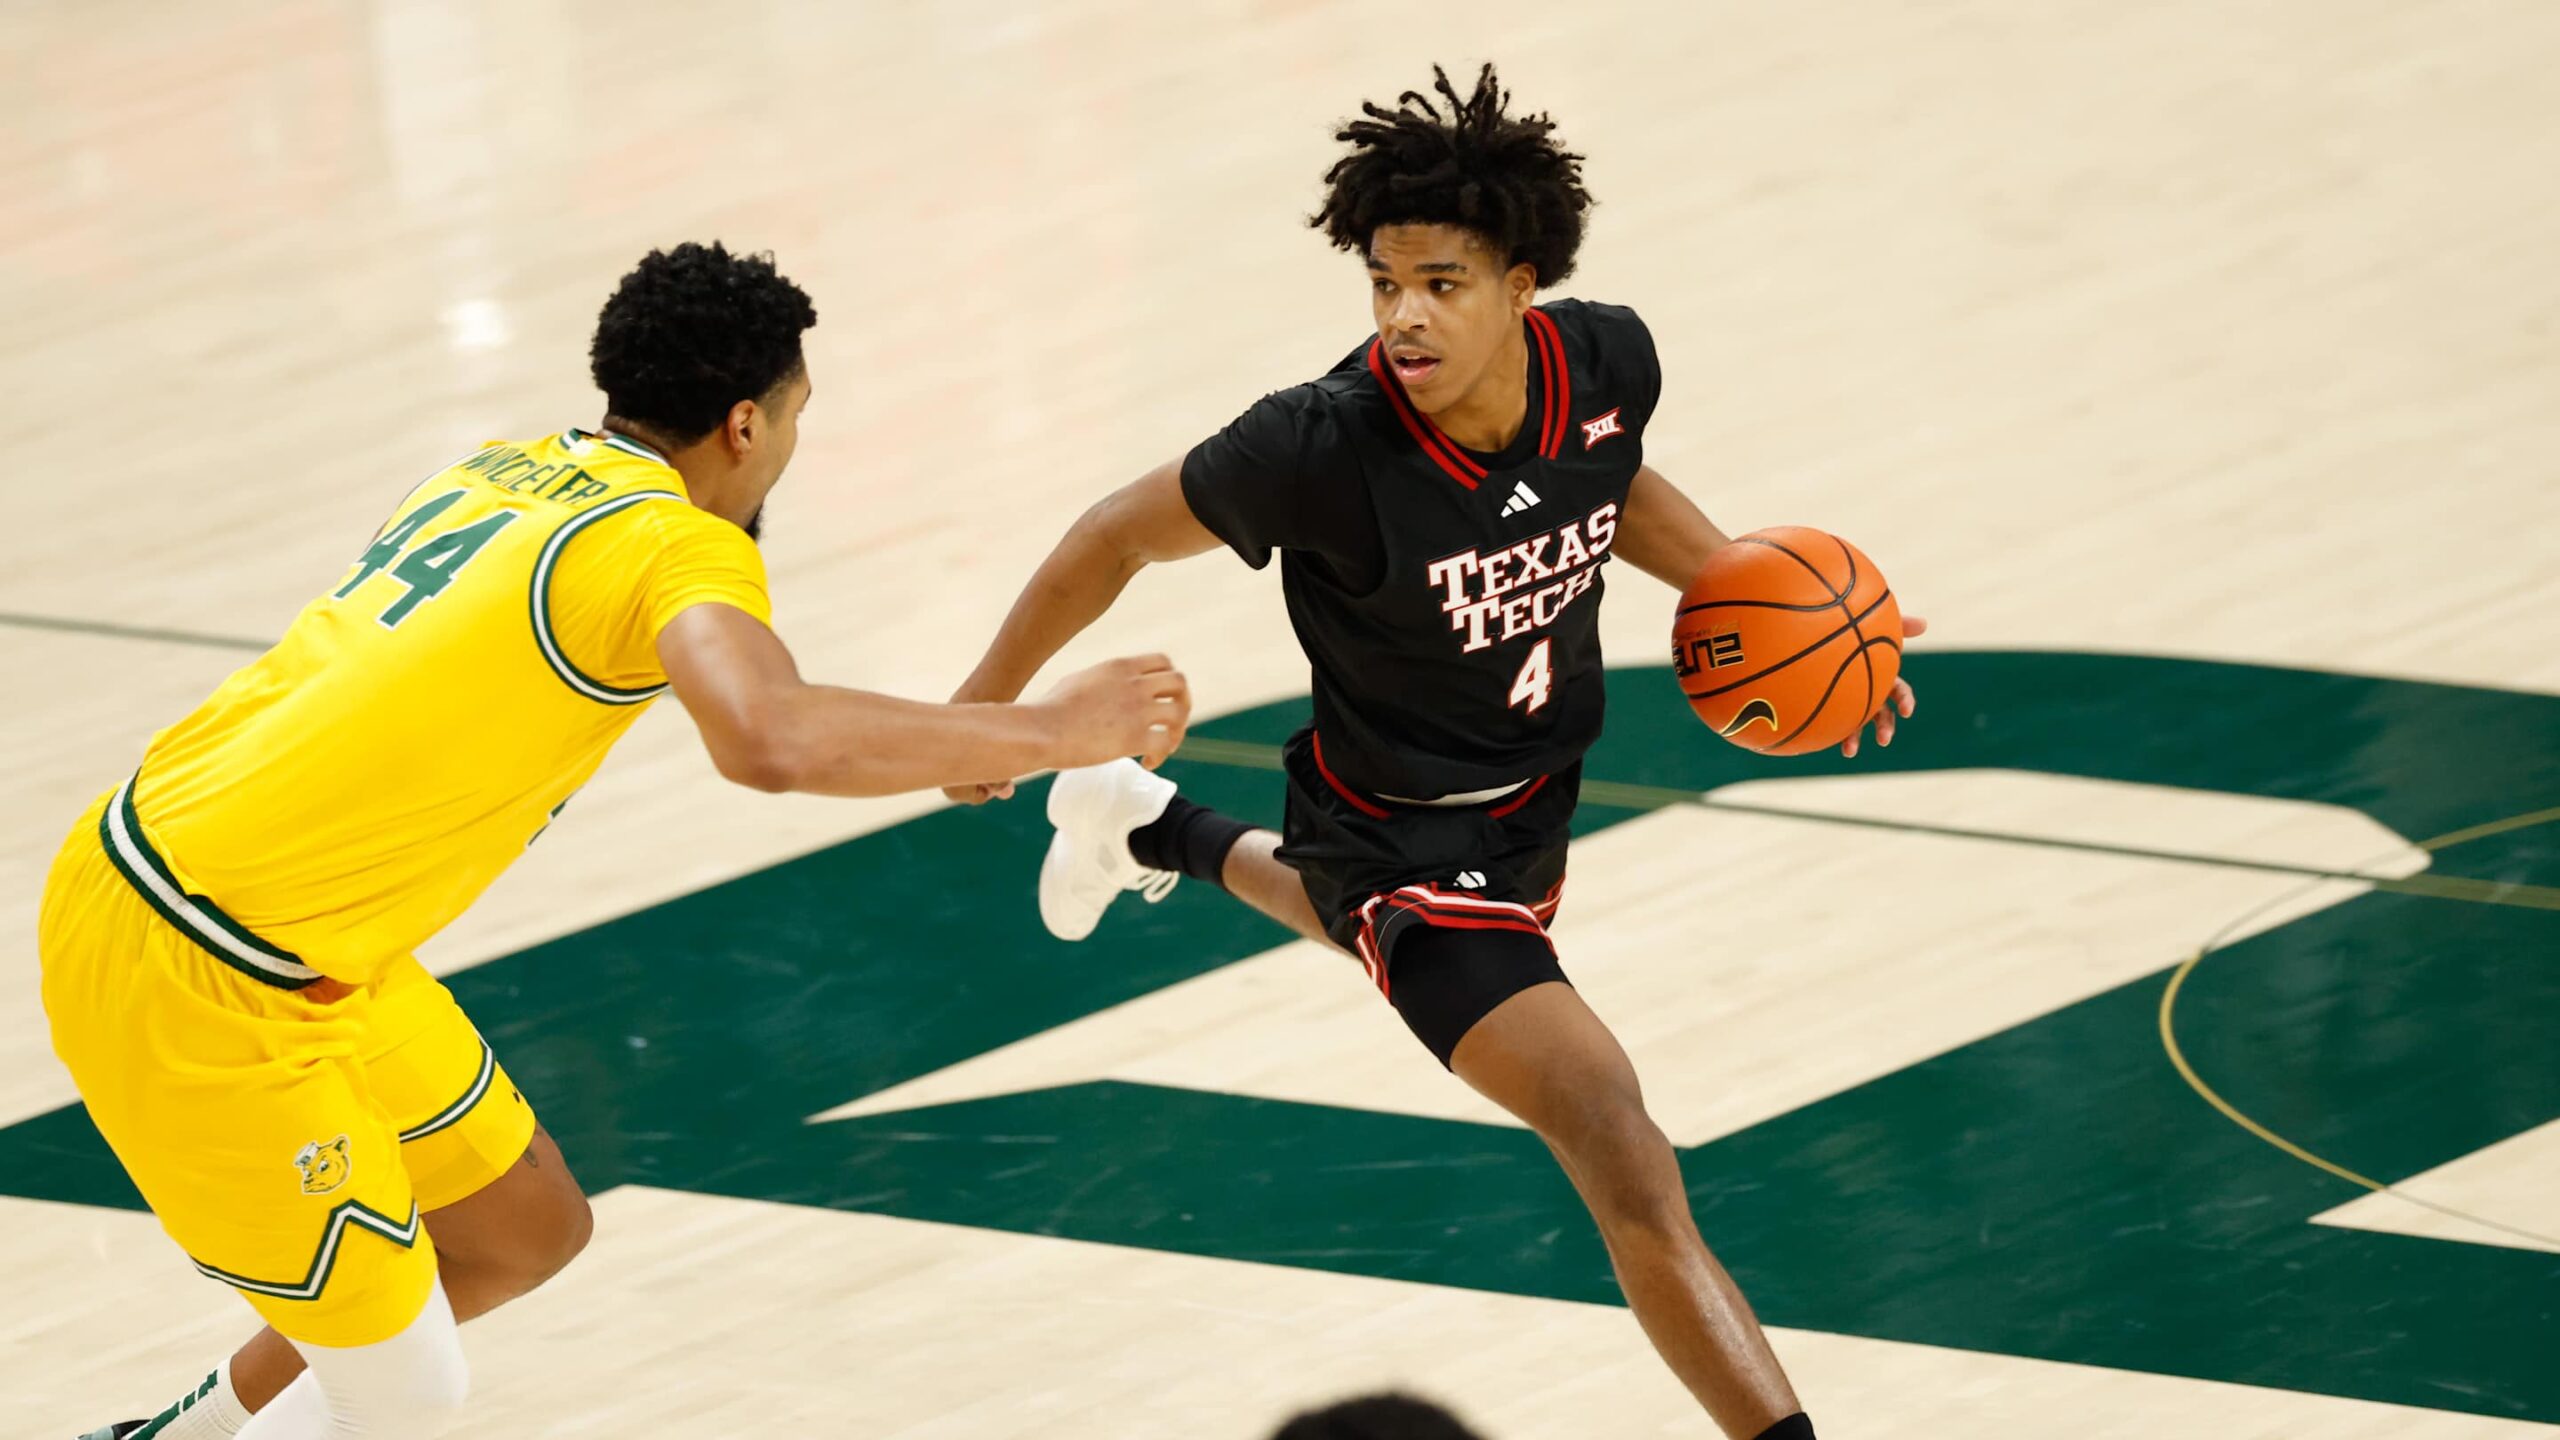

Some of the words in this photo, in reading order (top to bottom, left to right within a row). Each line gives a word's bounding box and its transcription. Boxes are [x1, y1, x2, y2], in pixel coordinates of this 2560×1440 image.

[332, 488, 522, 630] 44
[1426, 500, 1618, 614] TEXAS
[1451, 562, 1600, 654] TECH
[1509, 637, 1553, 715] 4
